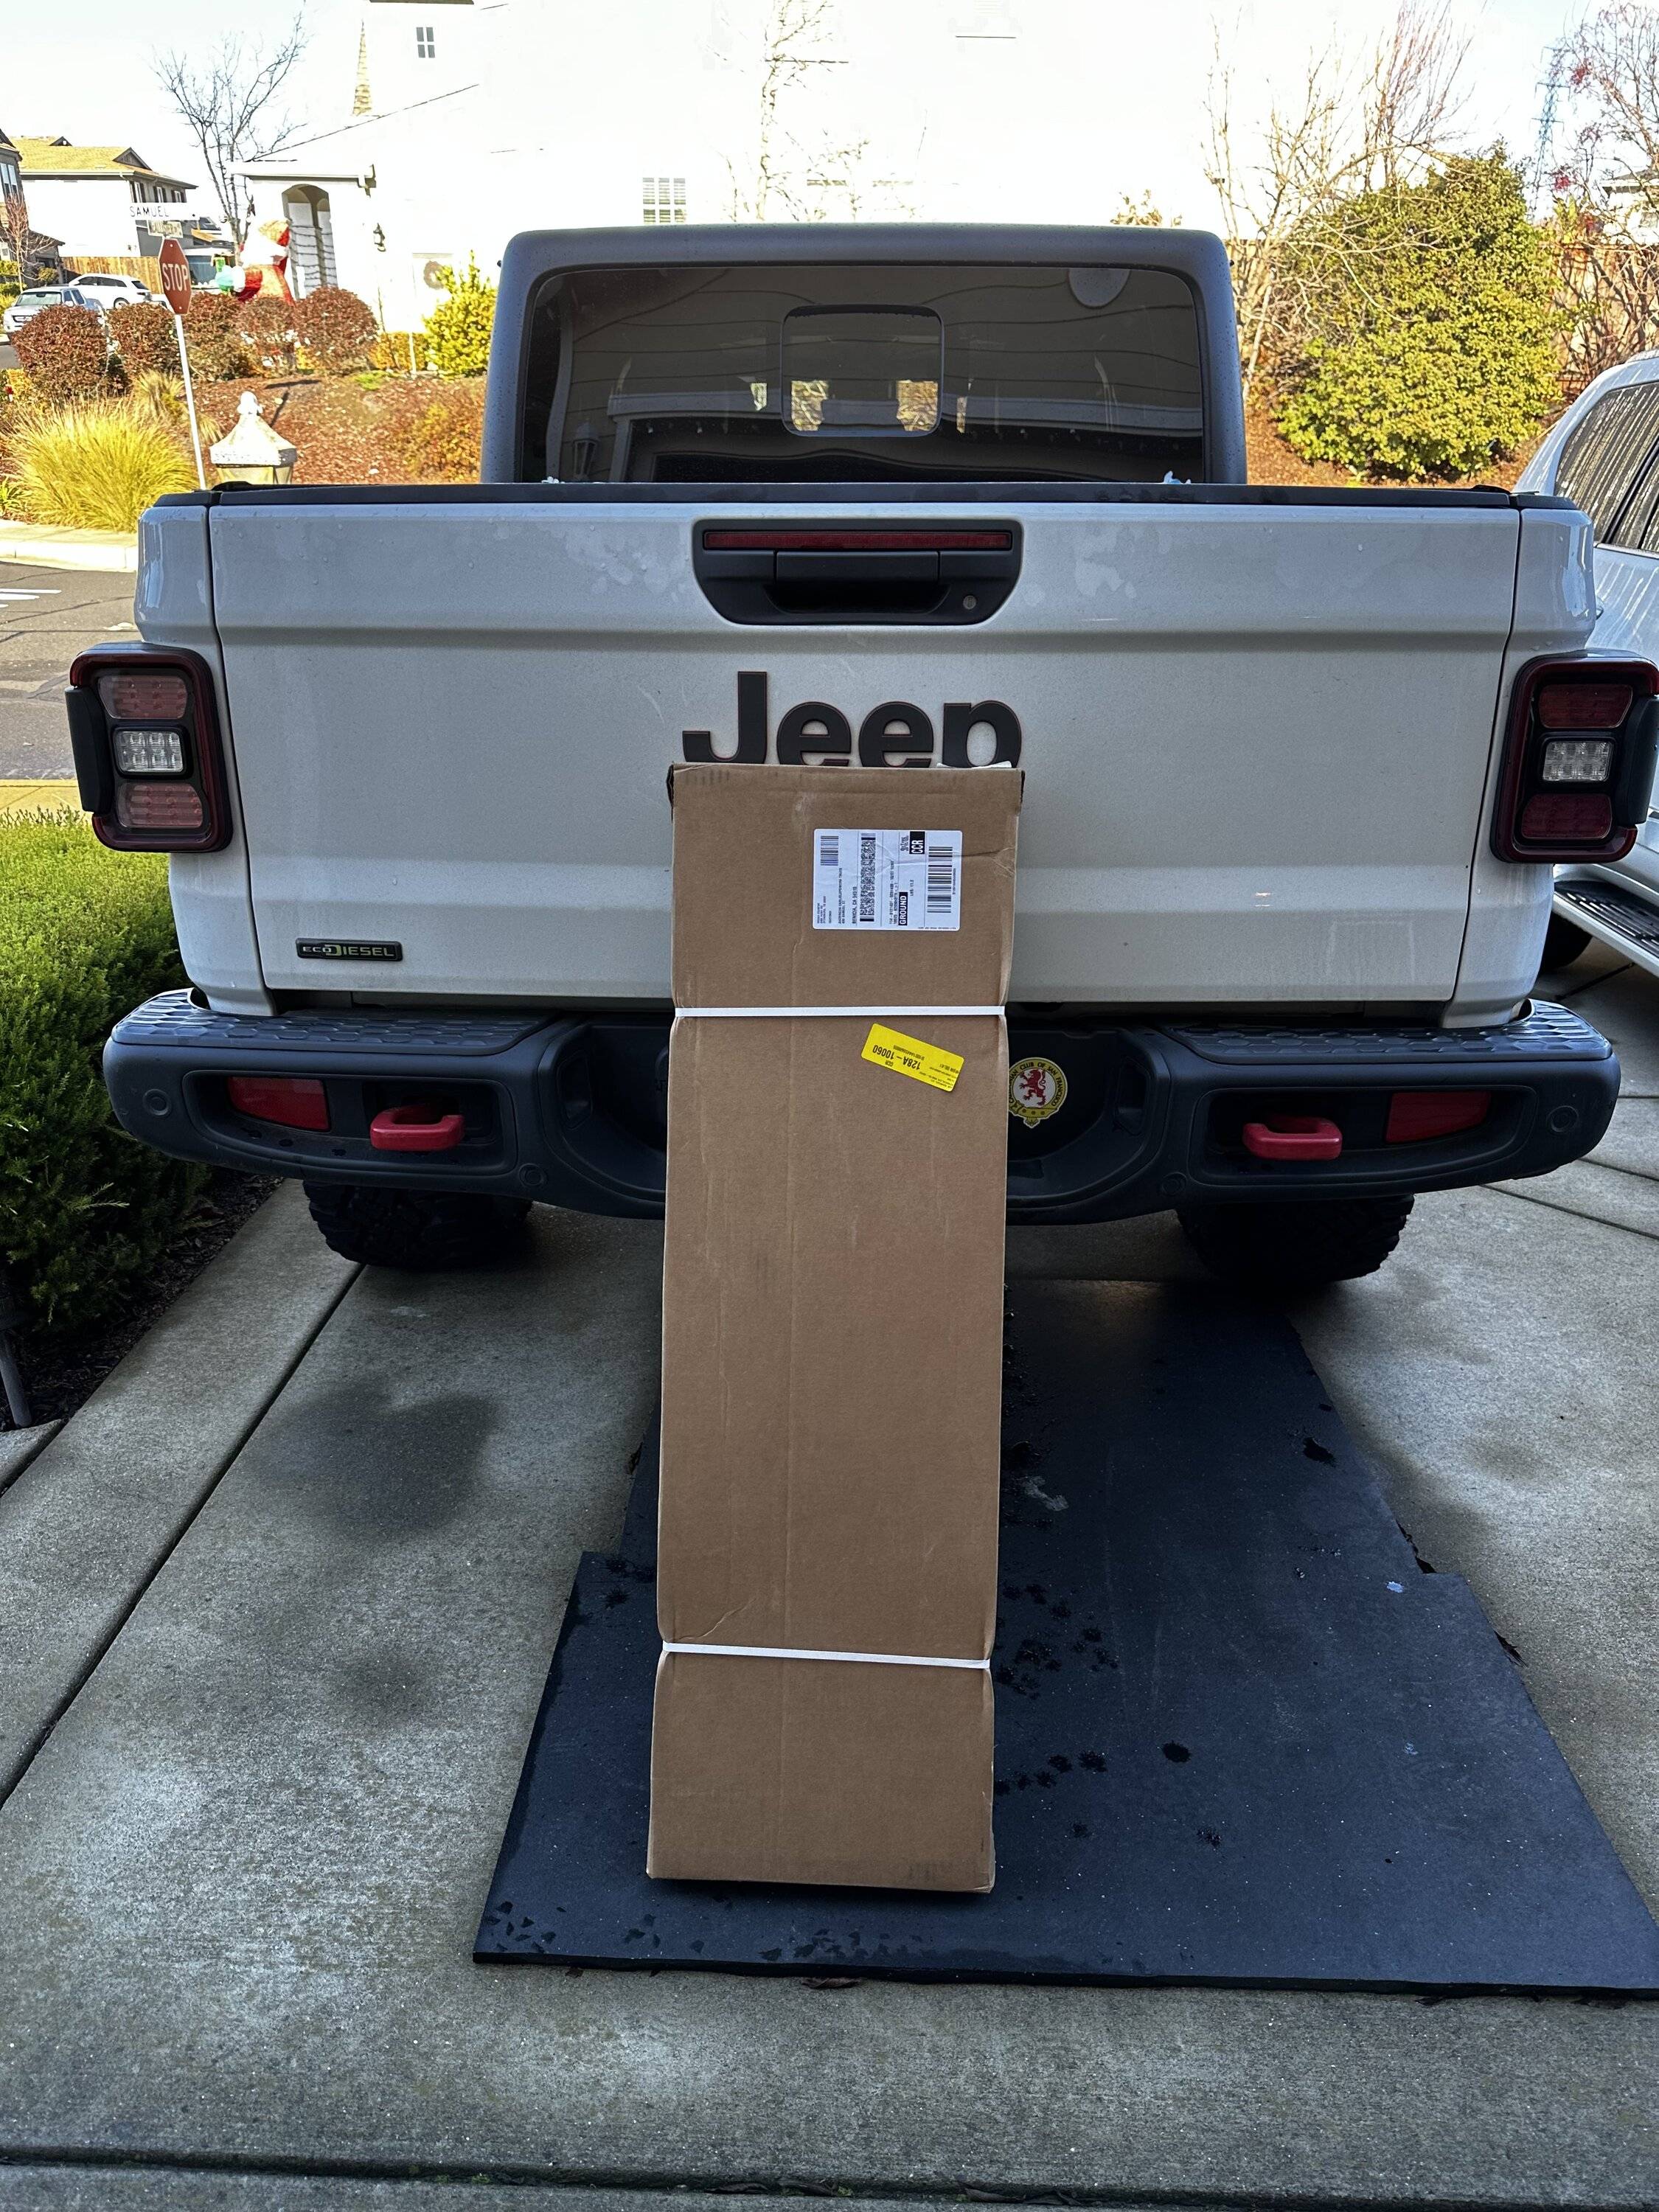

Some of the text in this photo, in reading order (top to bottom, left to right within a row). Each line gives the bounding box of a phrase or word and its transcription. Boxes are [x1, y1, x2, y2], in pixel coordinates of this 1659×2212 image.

[129, 206, 170, 217] SAMUEL
[162, 262, 189, 291] STOP
[911, 840, 924, 854] CCR
[899, 895, 907, 925] GROUND
[1020, 1062, 1034, 1070] CLUB
[1048, 1065, 1058, 1076] SAN
